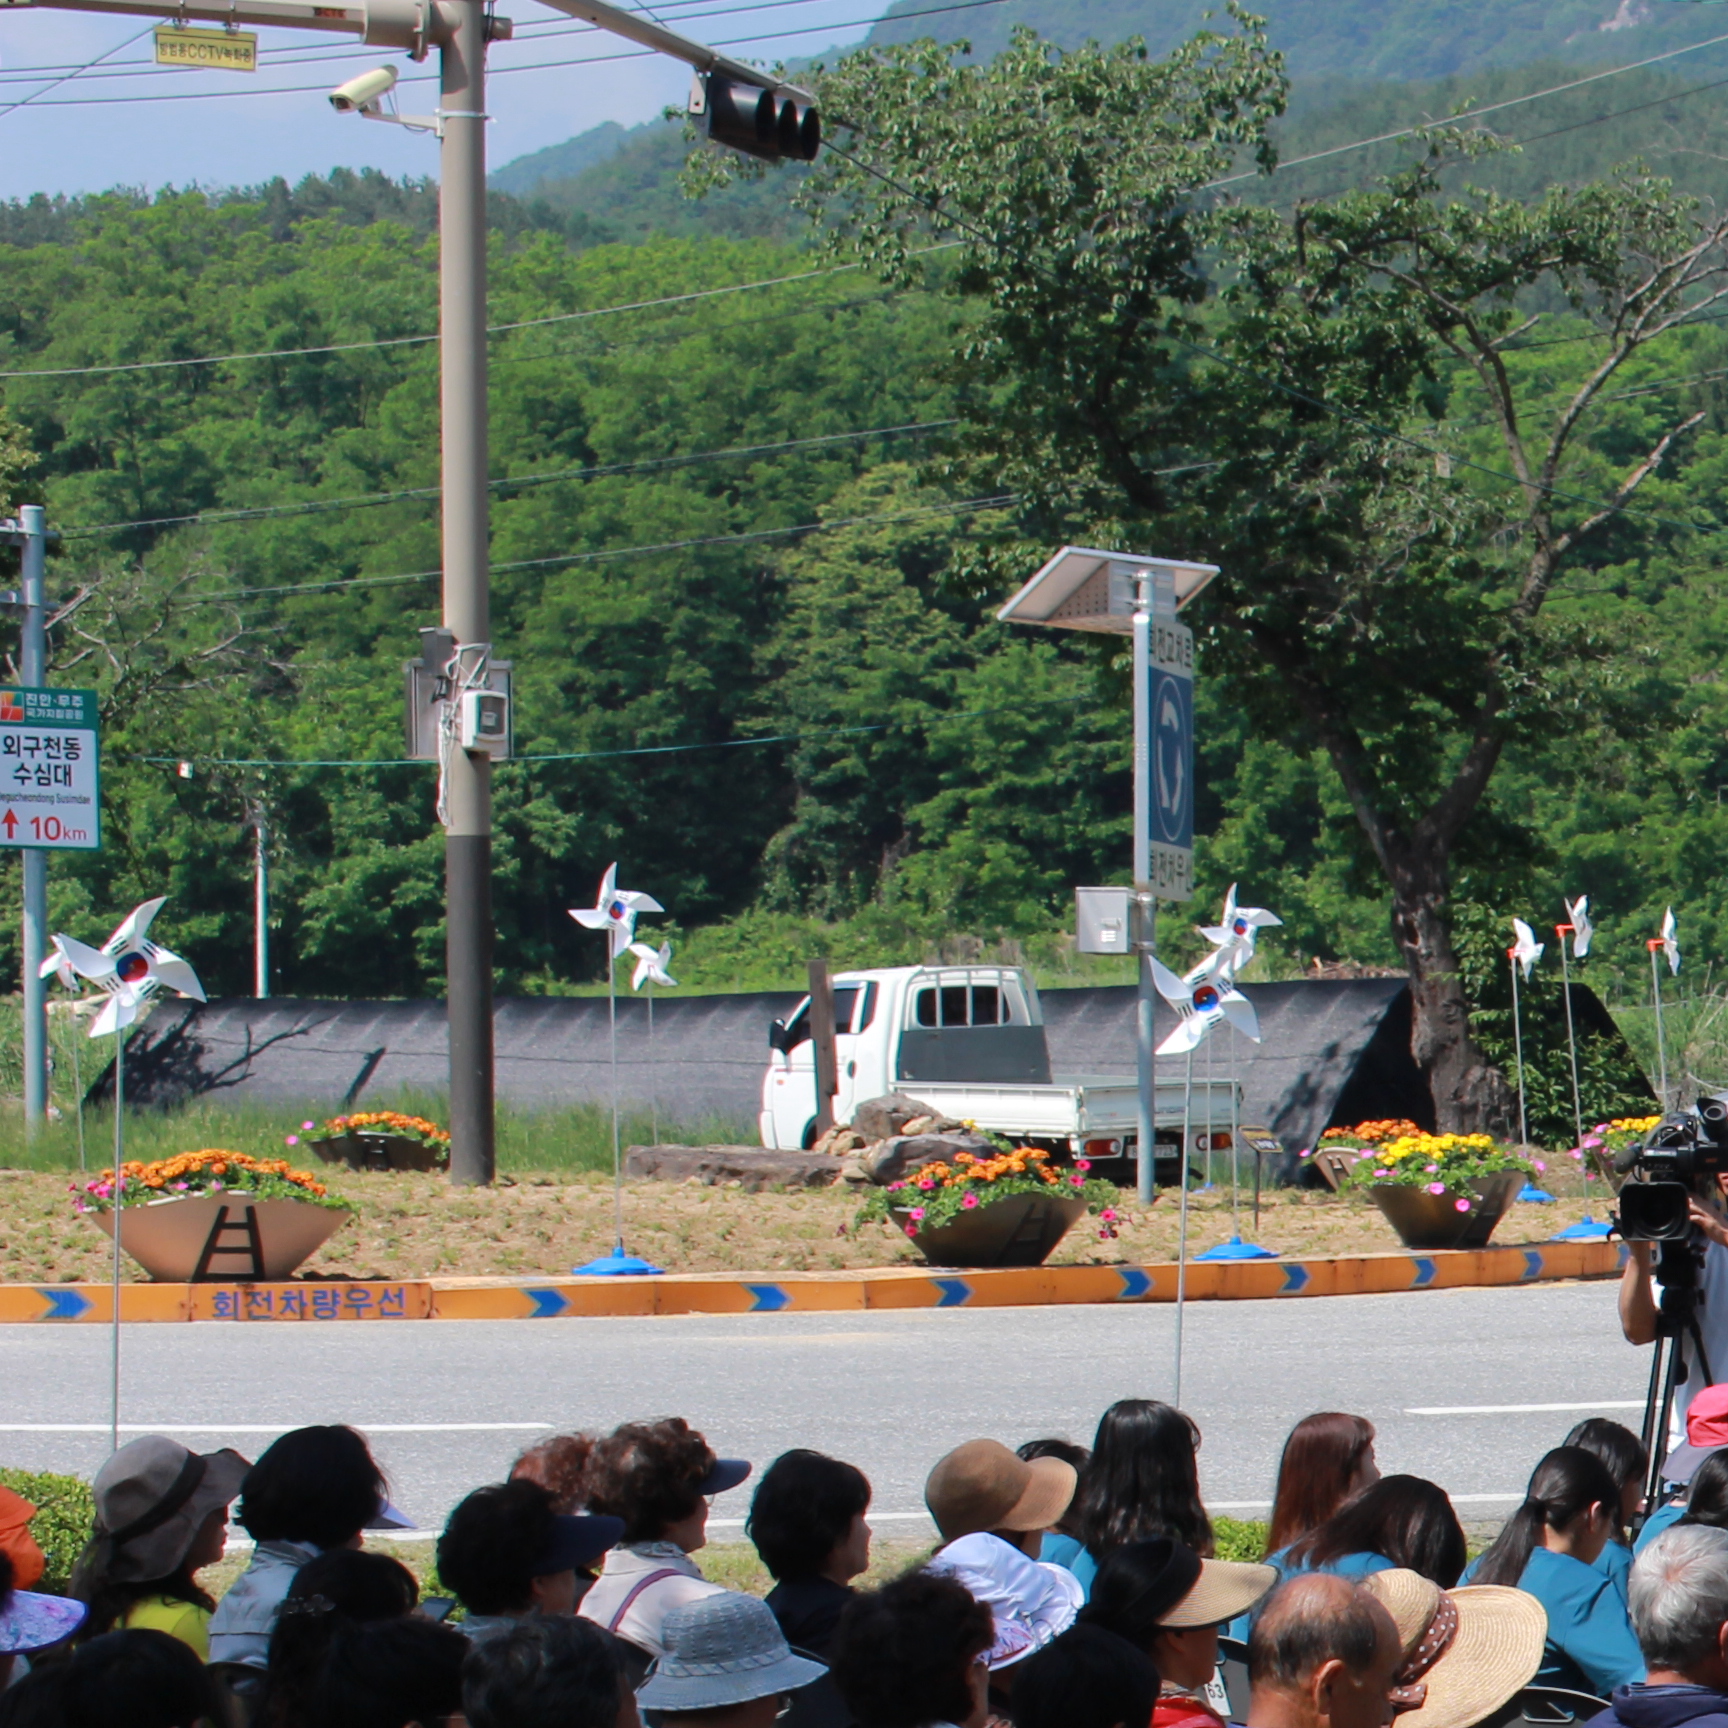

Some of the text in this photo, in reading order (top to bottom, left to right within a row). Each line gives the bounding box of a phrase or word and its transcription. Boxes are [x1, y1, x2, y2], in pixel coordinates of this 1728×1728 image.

[3, 734, 82, 761] 외구천동
[13, 762, 73, 788] 수심대
[212, 1287, 406, 1320] 회전차량우선
[1208, 1683, 1225, 1698] 63
